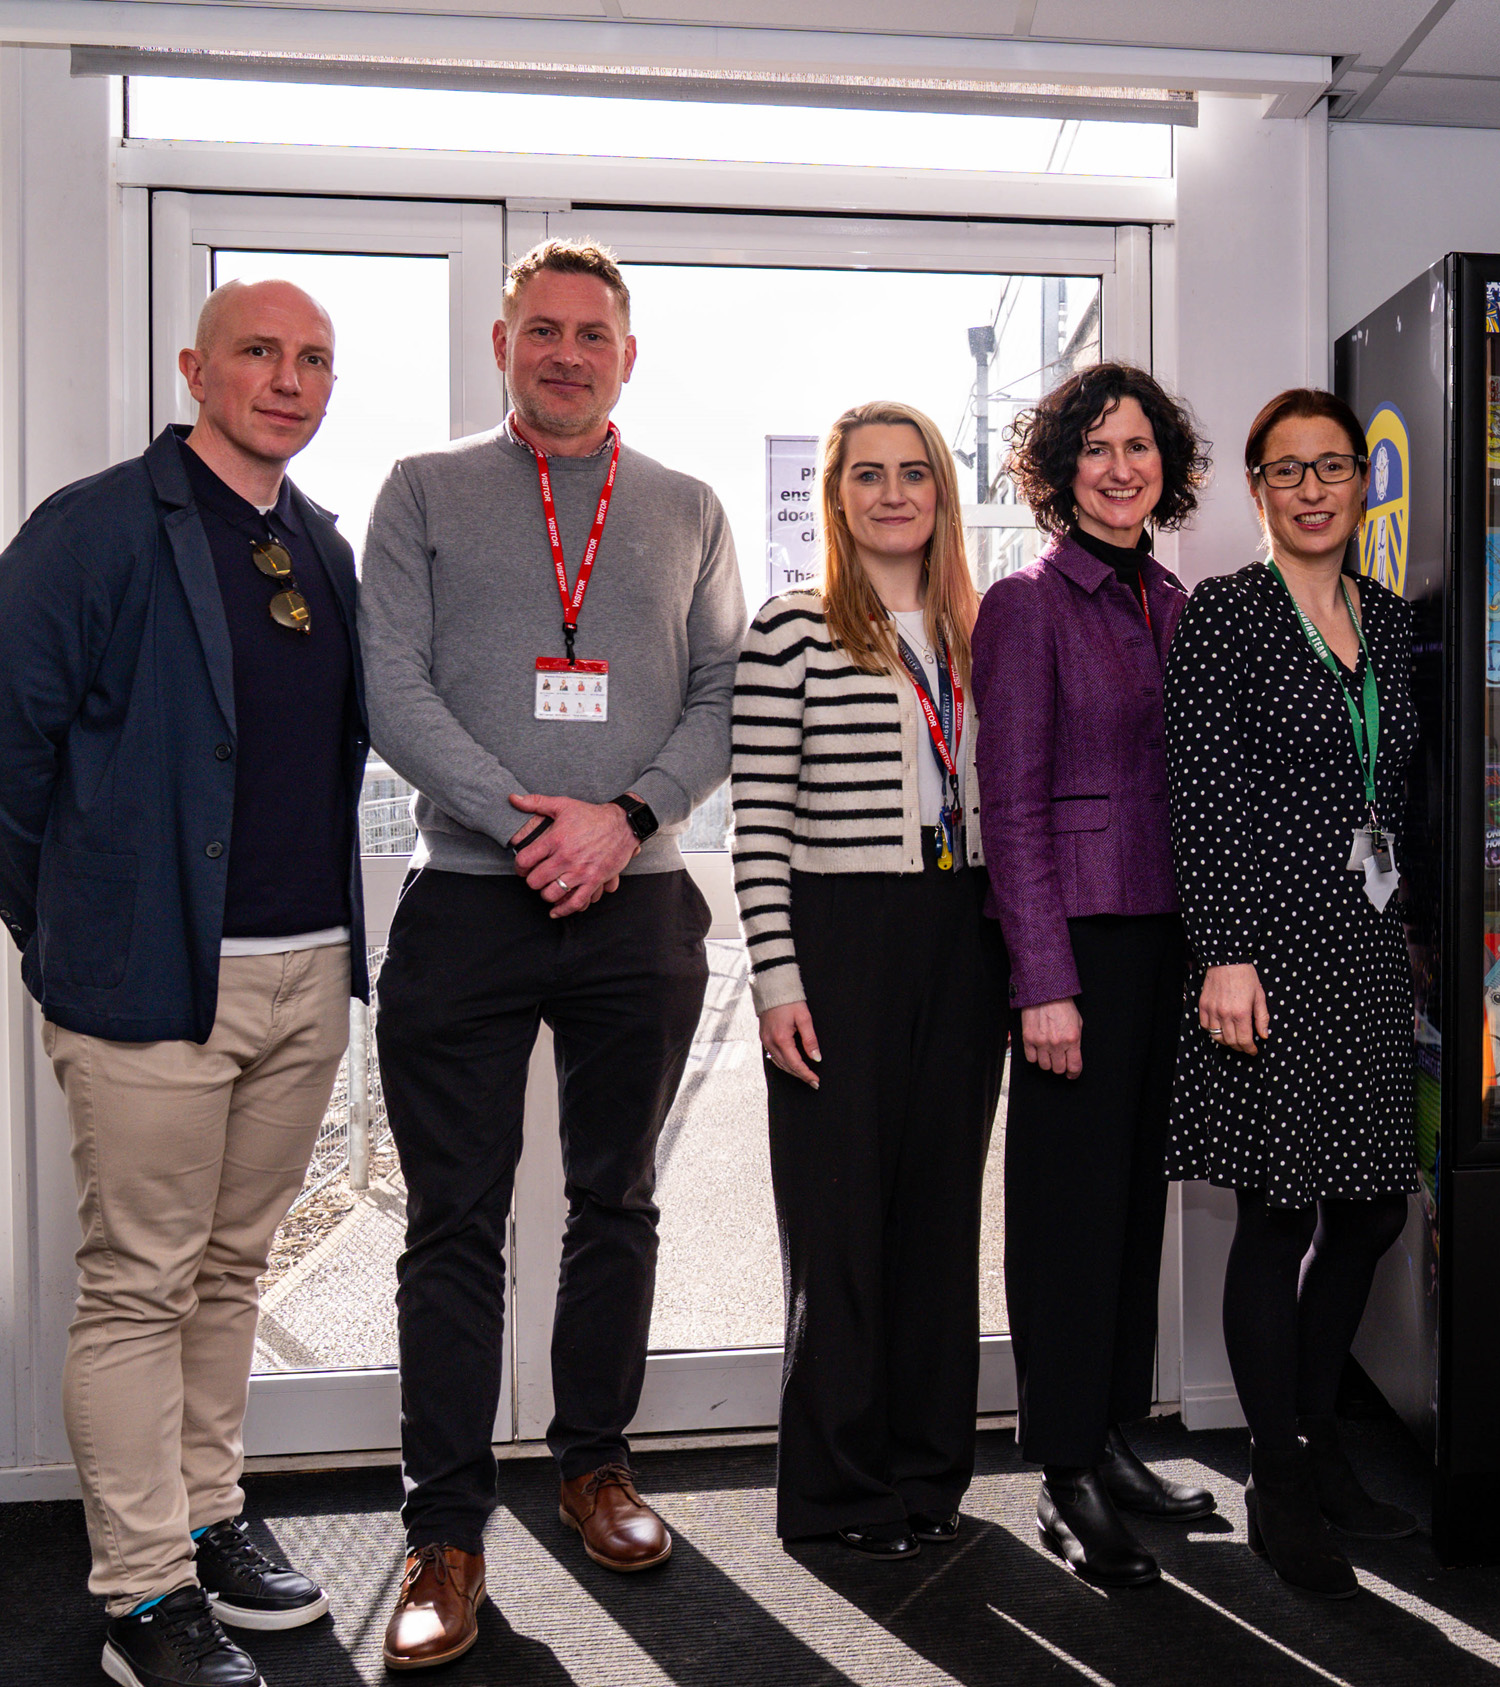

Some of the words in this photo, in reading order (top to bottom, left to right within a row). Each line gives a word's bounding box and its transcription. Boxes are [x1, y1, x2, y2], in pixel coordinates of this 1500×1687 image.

[541, 473, 551, 502] VISITOR
[607, 460, 616, 486] VISITOR
[596, 499, 607, 525] VISITOR
[548, 517, 559, 547] VISITOR
[584, 538, 597, 566] VISITOR
[556, 562, 567, 592] VISITOR
[572, 579, 586, 608] VISITOR
[1311, 637, 1328, 659] TEAM
[922, 698, 937, 728] VISITOR
[937, 741, 952, 770] VISITOR
